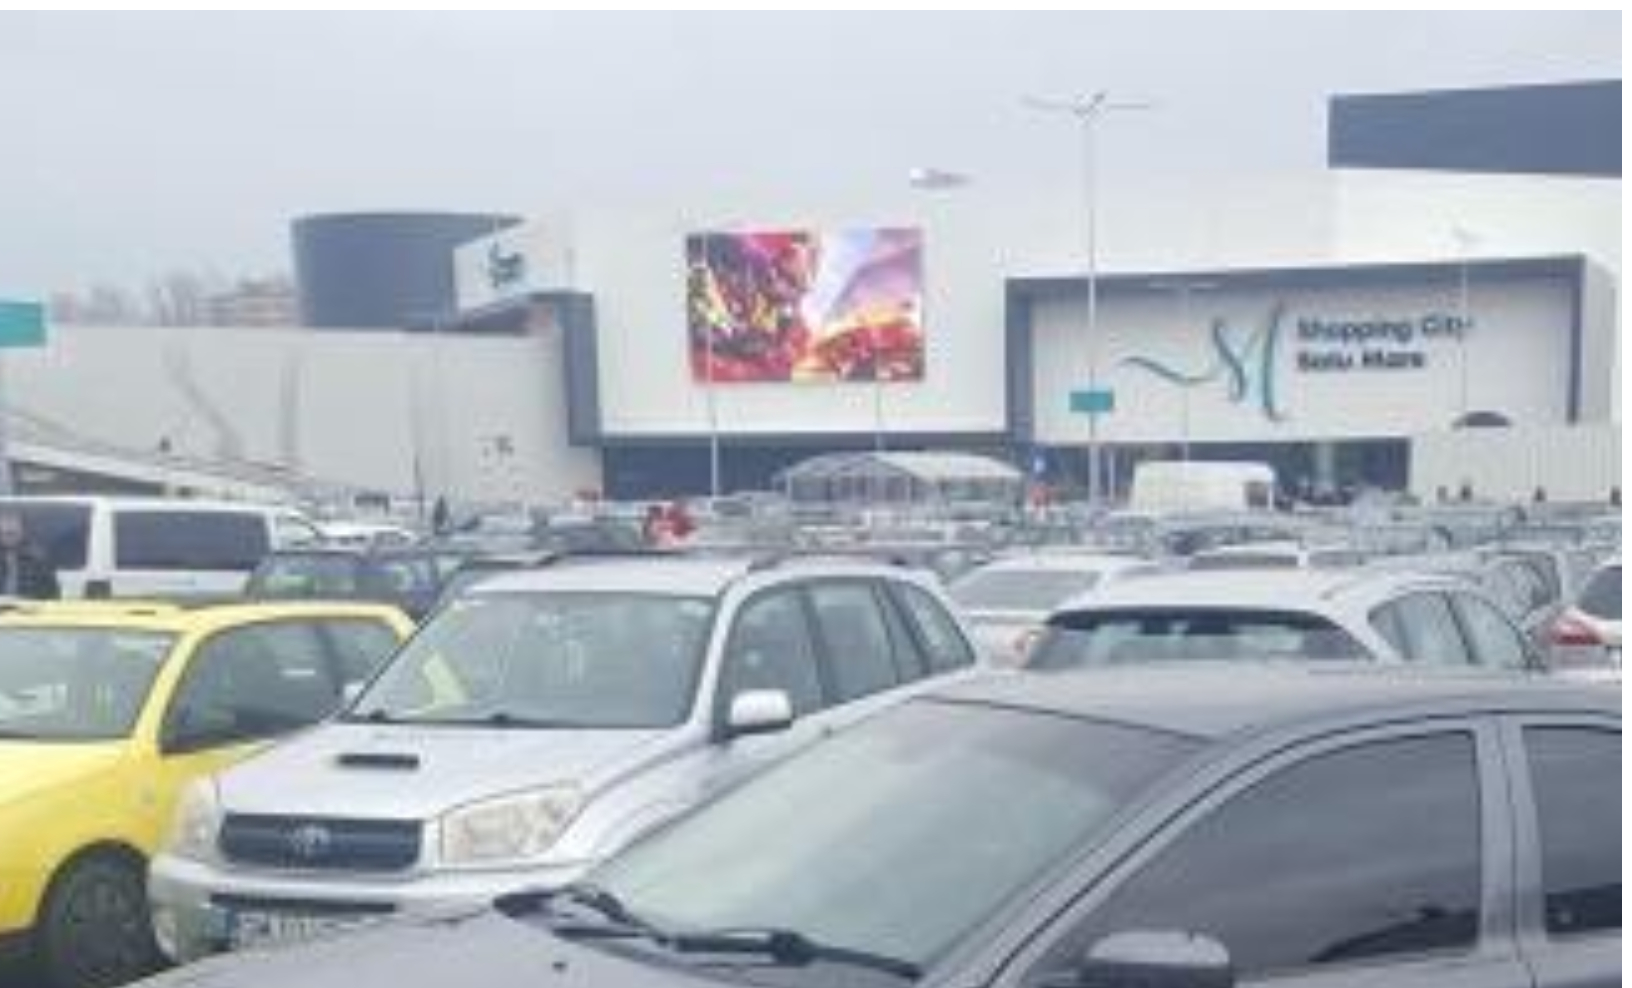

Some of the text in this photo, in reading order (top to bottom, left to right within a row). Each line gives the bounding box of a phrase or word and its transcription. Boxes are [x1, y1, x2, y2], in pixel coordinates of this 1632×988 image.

[1297, 315, 1413, 343] Shopping
[1297, 347, 1425, 374] Satu Mare
